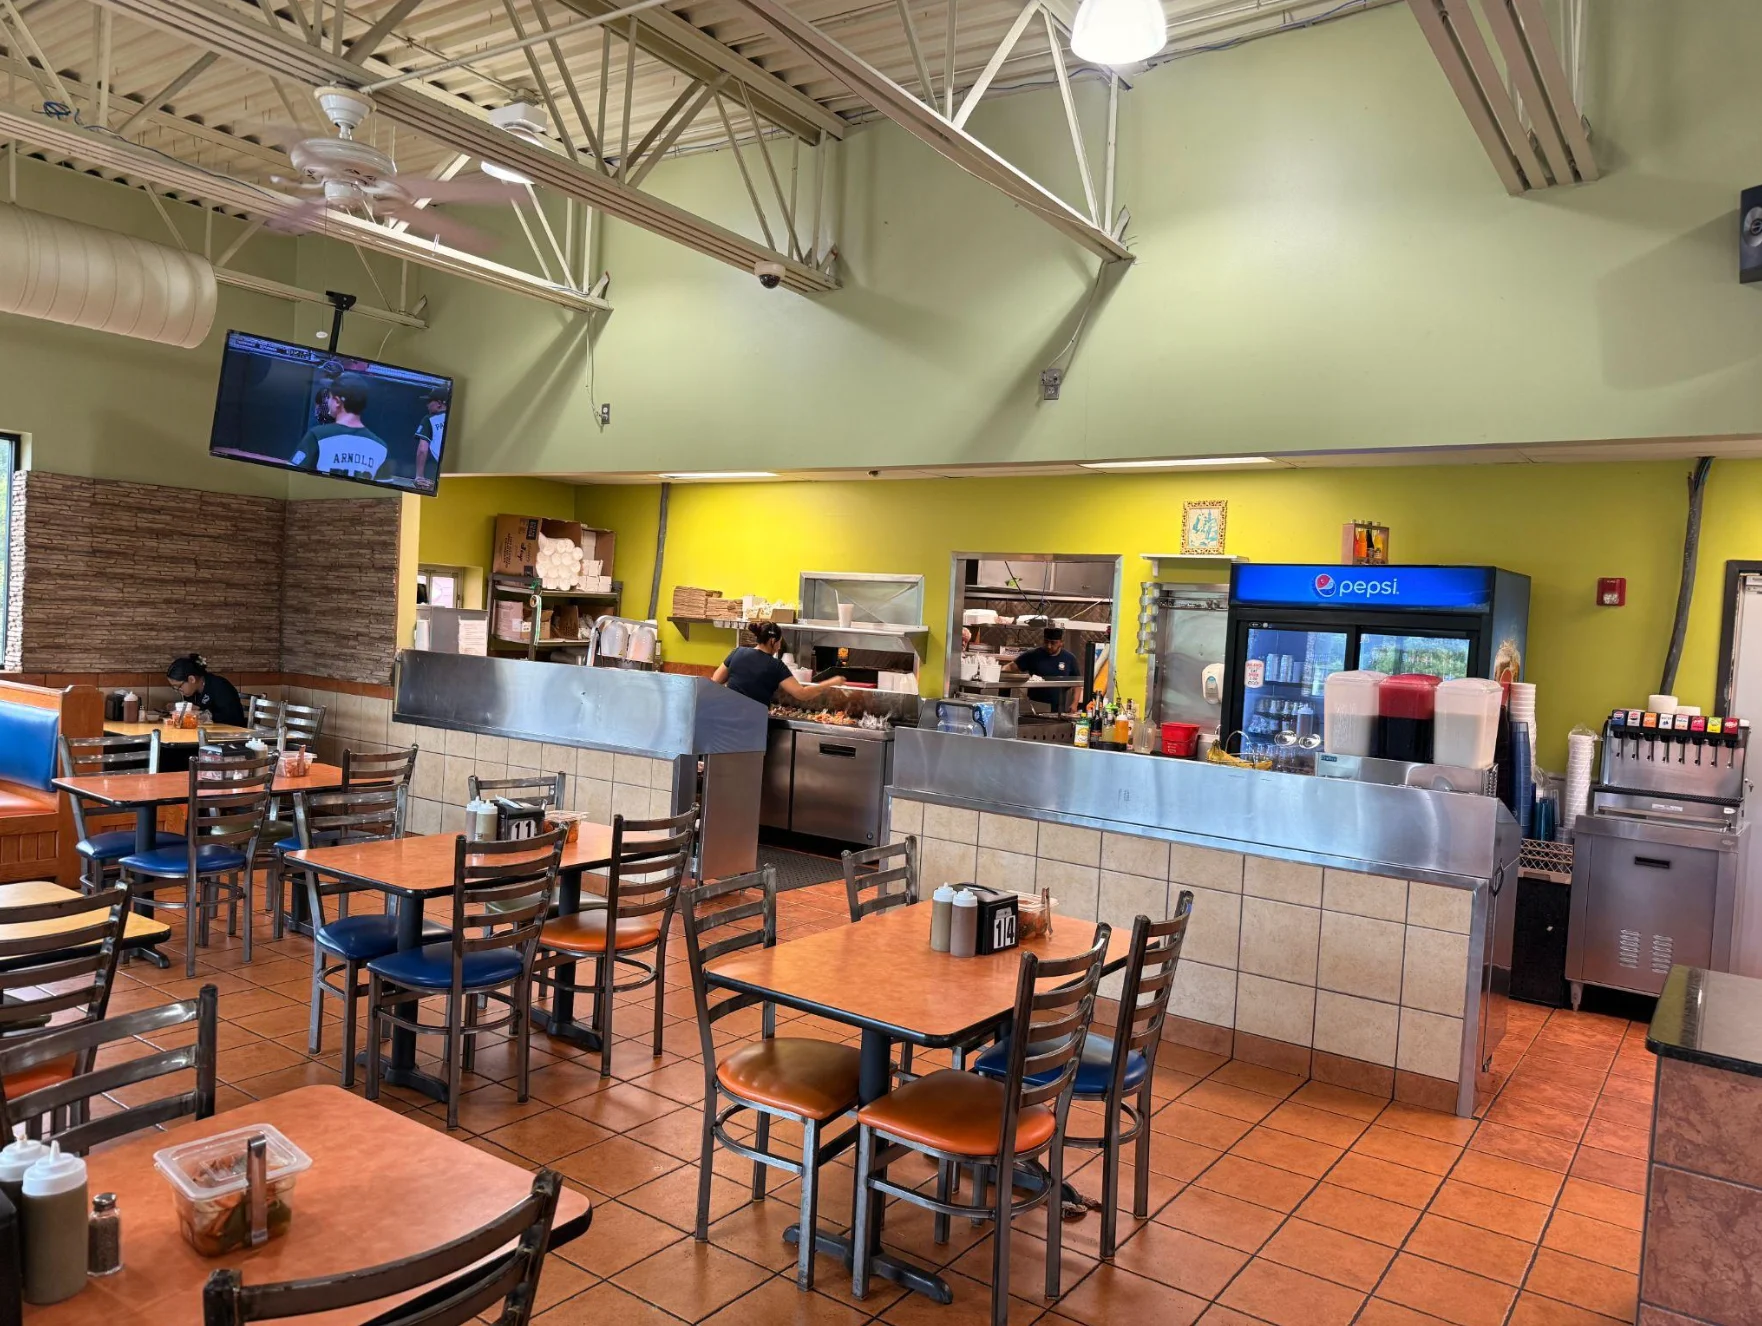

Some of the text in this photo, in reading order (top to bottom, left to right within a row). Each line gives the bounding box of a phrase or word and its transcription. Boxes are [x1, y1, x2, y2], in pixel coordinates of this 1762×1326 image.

[333, 453, 374, 469] ARNOLD
[1339, 578, 1398, 598] pepsi
[515, 820, 532, 840] 11
[996, 916, 1015, 947] 14
